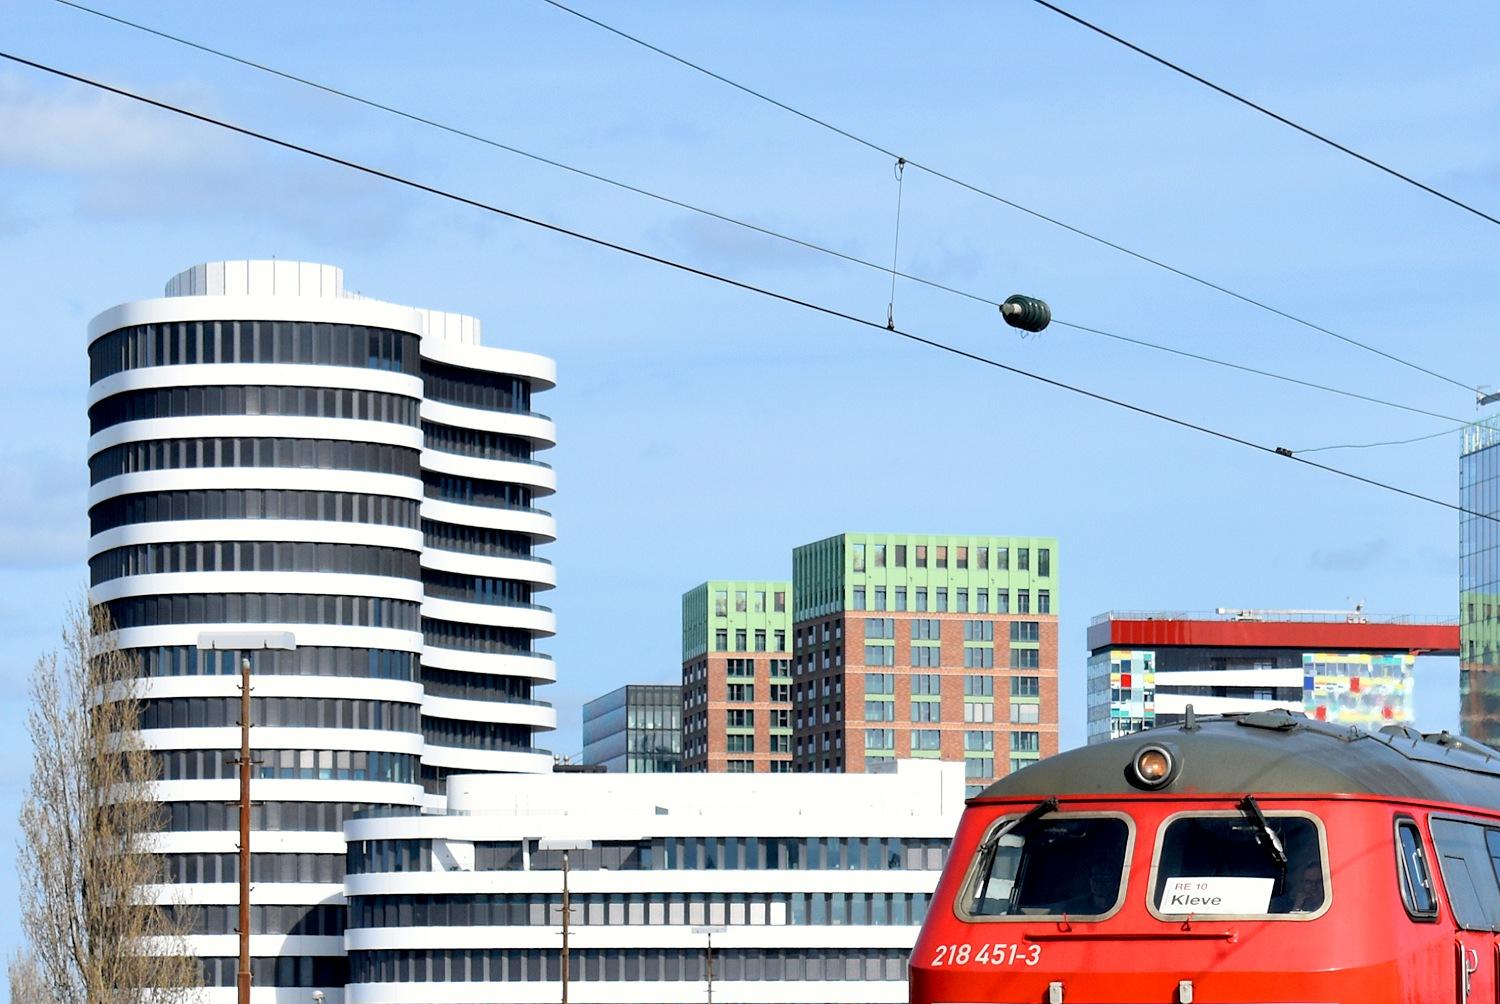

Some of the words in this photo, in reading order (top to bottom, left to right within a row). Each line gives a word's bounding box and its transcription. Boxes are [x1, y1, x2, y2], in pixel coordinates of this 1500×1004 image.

[1175, 883, 1191, 891] RE
[1196, 883, 1208, 891] 10
[1170, 894, 1222, 906] Kleve
[931, 944, 971, 967] 218
[974, 943, 1041, 966] 451-3
